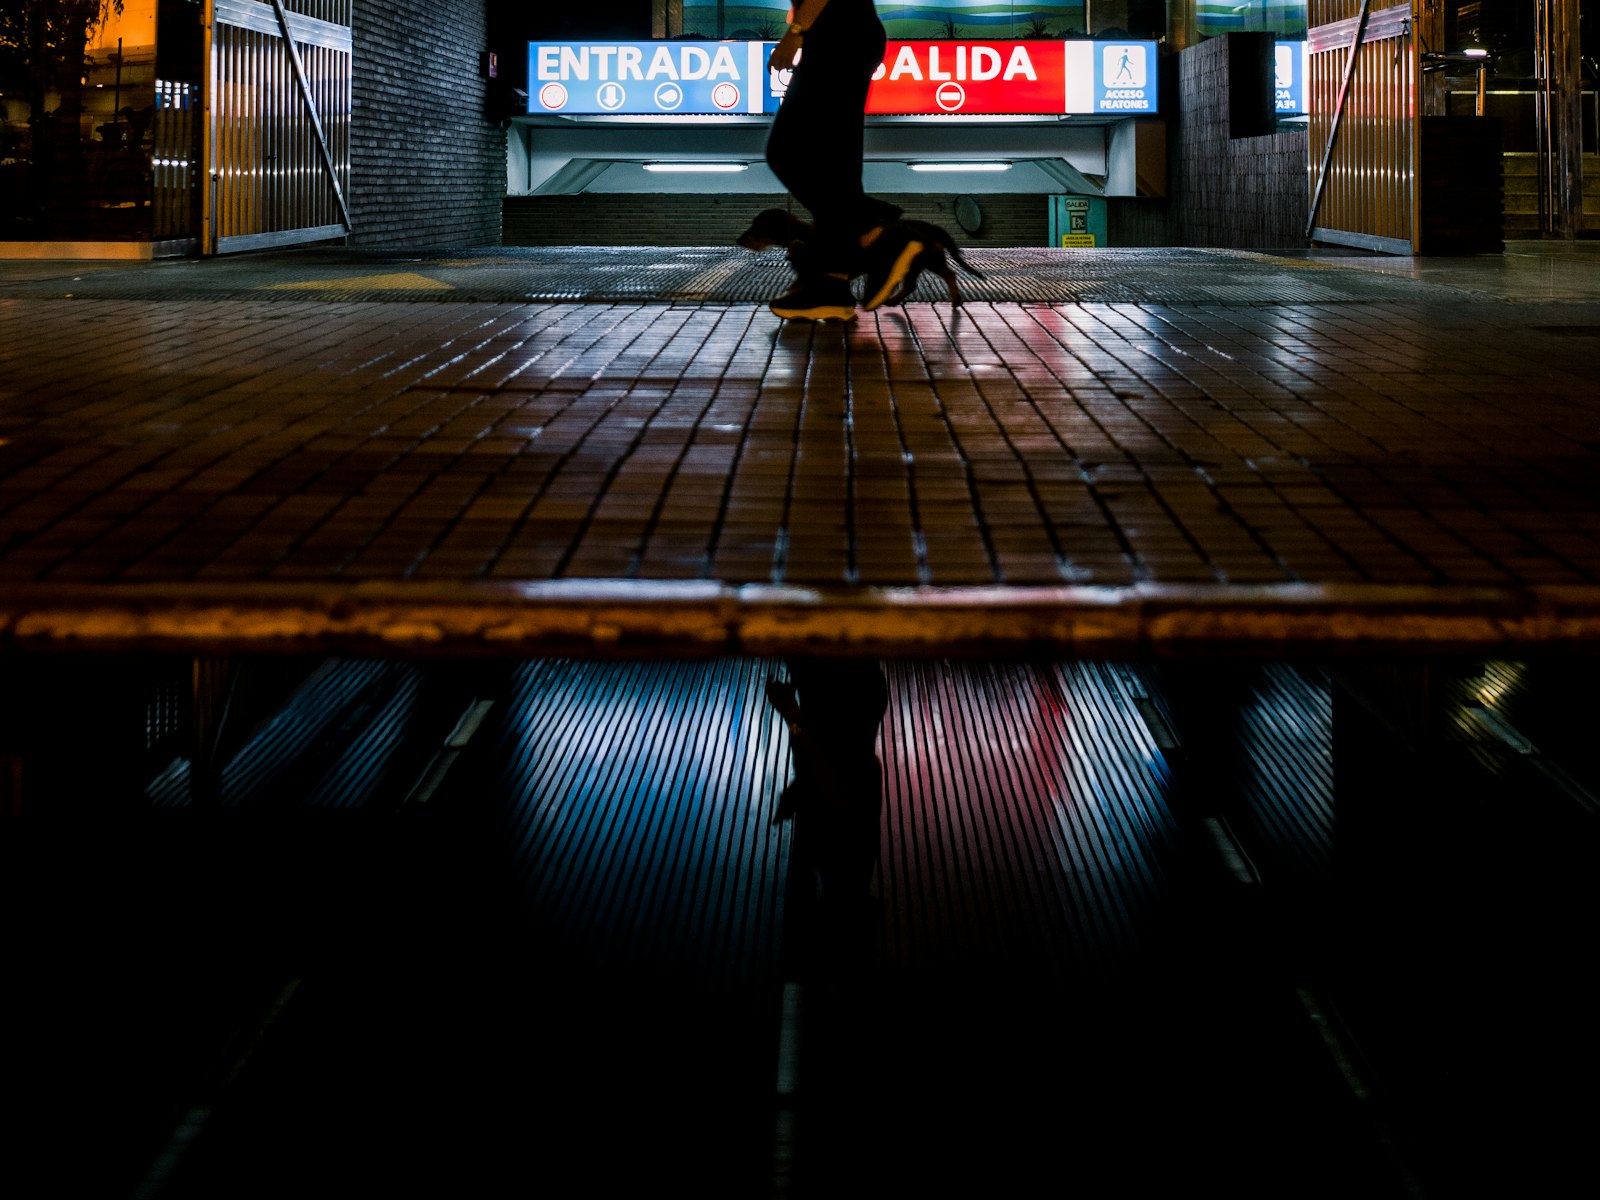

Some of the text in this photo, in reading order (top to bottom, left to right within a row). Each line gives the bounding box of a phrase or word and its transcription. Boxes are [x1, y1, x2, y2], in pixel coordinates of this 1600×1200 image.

[537, 46, 741, 81] ENTRADA
[1105, 90, 1144, 99] ACCESO
[1100, 100, 1149, 109] PEATONES
